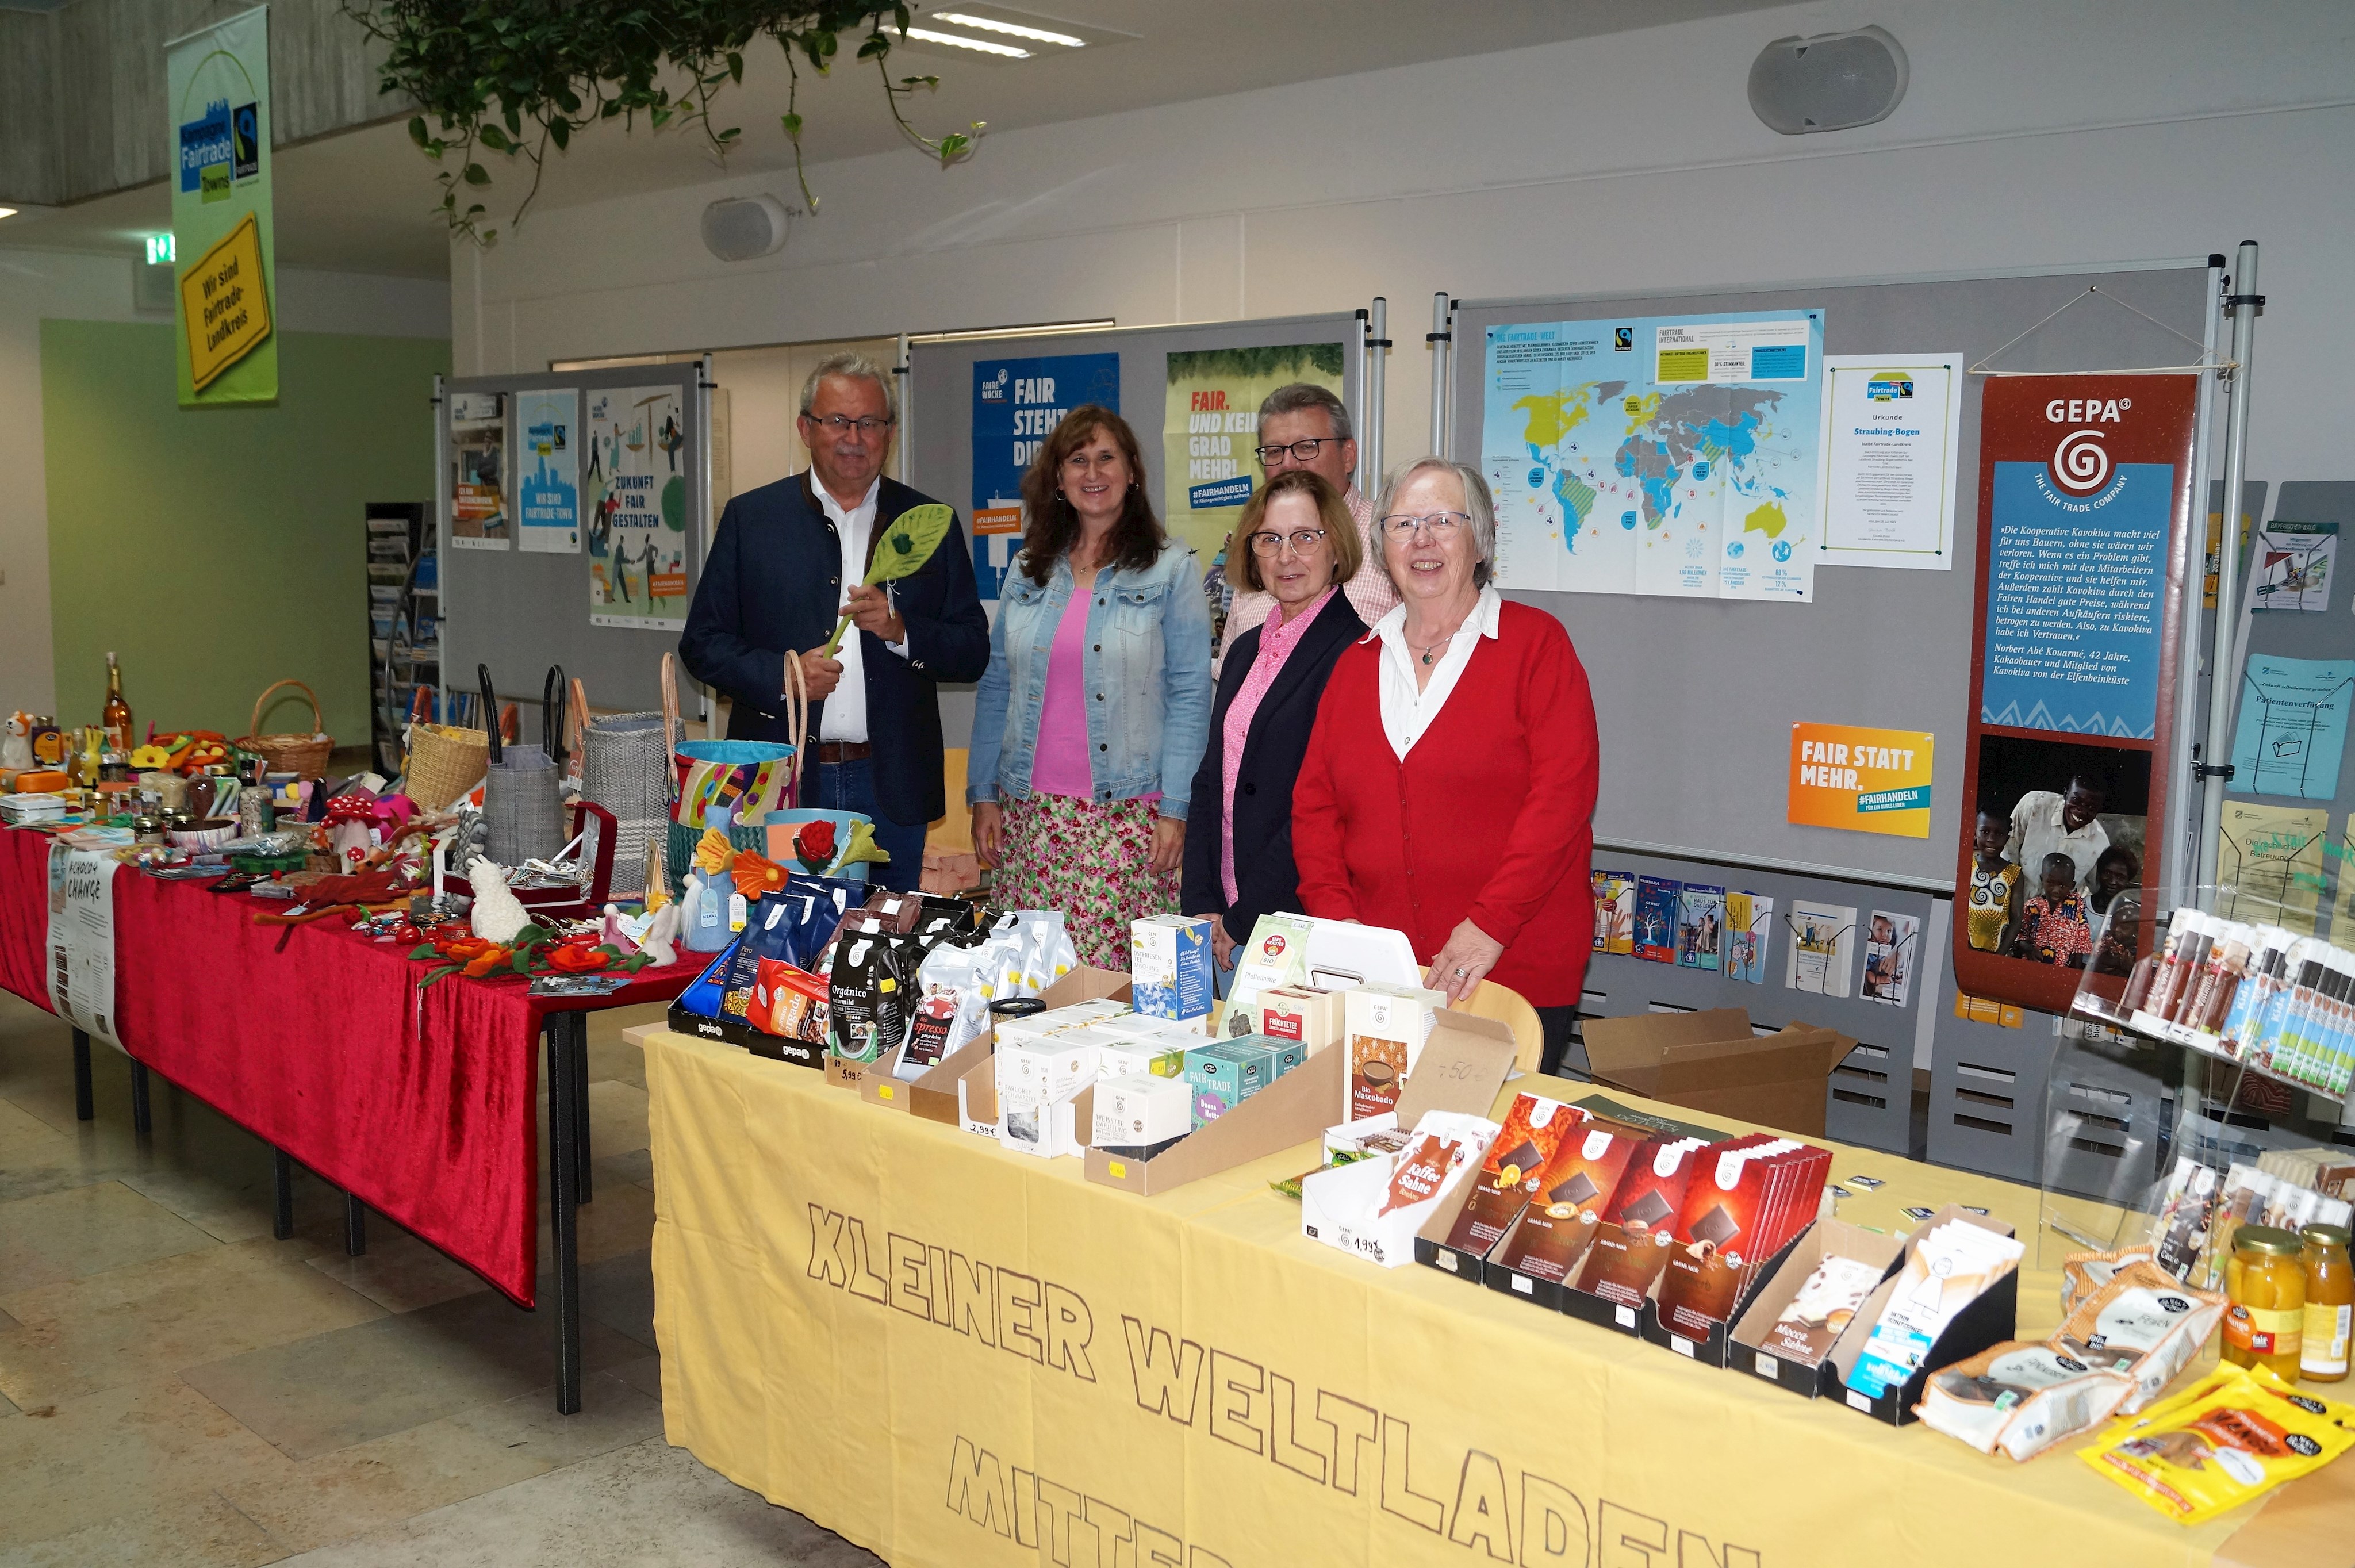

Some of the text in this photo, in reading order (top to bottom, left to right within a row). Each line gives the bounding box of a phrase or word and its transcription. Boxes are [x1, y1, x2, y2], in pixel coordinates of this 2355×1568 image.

[182, 139, 231, 170] Fairtrade
[203, 255, 239, 299] Wir sind
[207, 310, 248, 352] Landkreis
[1659, 335, 1694, 343] INTERNATIONAL
[982, 381, 999, 390] FAIRE
[1014, 378, 1055, 404] FAIR
[982, 390, 1002, 399] WOCHE
[1191, 390, 1230, 412] FAIR.
[1188, 413, 1221, 434] UND
[1854, 427, 1920, 437] Straubing-Bogen
[1188, 436, 1232, 457] GRAD
[1189, 458, 1238, 480] MEHR!
[616, 475, 654, 489] ZUKUNFT
[1192, 483, 1249, 499] #FAIRHANDELN
[2034, 472, 2128, 513] THE FAIR TRADE COMPANY
[536, 493, 561, 505] WIR SIND
[625, 494, 645, 509] FAIR
[526, 507, 572, 520] FAIRTRADE-TOWN
[613, 513, 659, 528] GESTALTEN
[976, 514, 1017, 524] #FAIRHANDELN
[2001, 526, 2160, 539] »Die Kooperative Kavokiva macht viel
[1998, 536, 2013, 547] für
[2032, 538, 2065, 548] Bauern,
[2069, 539, 2089, 548] ohne
[2092, 540, 2104, 549] sie
[2108, 542, 2134, 550] wären
[2138, 542, 2154, 550] wir
[2000, 549, 2034, 557] verloren.
[2039, 550, 2062, 558] Wenn
[2077, 551, 2089, 560] ein
[2093, 552, 2128, 561] Problem
[2131, 554, 2151, 563] gibt,
[1999, 559, 2153, 574] treffe ich mich mit den Mitarbeitern
[1998, 570, 2147, 586] der Kooperative und sie helfen mir.
[1997, 582, 2154, 598] Außerdem zahlt Kavokiva durch den
[1997, 593, 2150, 609] Fairen Handel gute Preise, während
[1997, 605, 2150, 623] ich bei anderen Aufkäufern riskiere,
[1996, 616, 2028, 627] betrogen
[2042, 620, 2073, 628] werden.
[2076, 621, 2096, 631] Also,
[2112, 623, 2152, 634] Kavokiva
[1995, 627, 2080, 641] habe ich Vertrauen.«
[1995, 643, 2024, 653] Norbert
[2027, 646, 2043, 655] Abé
[2046, 647, 2085, 659] Kouarmé,
[2103, 652, 2130, 662] Jahre,
[1994, 655, 2042, 666] Kakaobauer
[2045, 660, 2061, 668] und
[2063, 660, 2099, 672] Mitglied
[1993, 666, 2030, 676] Kavokiva
[2050, 670, 2065, 679] der
[2066, 672, 2130, 685] Elfenbeinküste
[2256, 695, 2334, 710] Patientenverfügung
[1801, 740, 1915, 771] FAIR STATT
[1800, 764, 1863, 791] MEHR.
[1858, 790, 1919, 805] #FAIRHANDELN
[2262, 841, 2297, 851] rechtliche
[2250, 850, 2289, 862] Betreuung
[1639, 878, 1660, 886] FRAUENHAUS
[68, 879, 101, 904] CHANGE
[741, 945, 753, 953] Peru
[1267, 940, 1284, 948] KRÄUTER
[1133, 950, 1161, 961] OSTFRIESEN
[1134, 963, 1159, 972] MISCHUNG
[1245, 972, 1276, 983] Pfefferminze
[831, 984, 867, 998] Orgánico
[2237, 984, 2250, 1011] Kids
[833, 998, 854, 1006] naturmild
[2270, 994, 2285, 1022] Kids
[783, 994, 801, 1038] Cargado
[1269, 1017, 1298, 1030] FRÜCHTETEE
[698, 1023, 715, 1033] gepa
[783, 1045, 802, 1057] gepa
[842, 1069, 856, 1080] 5,99
[1190, 1071, 1207, 1084] FAIR
[1207, 1079, 1232, 1092] TRADE
[1354, 1090, 1393, 1105] Mascobado
[1096, 1114, 1125, 1127] WEISSTEE
[1096, 1121, 1127, 1135] DARJEELING
[1406, 1162, 1441, 1183] Kaffee
[1398, 1174, 1432, 1195] Sahne
[807, 1202, 1096, 1383] KLEINER
[2227, 1314, 2250, 1332] Mango
[1774, 1323, 1808, 1341] Mocca
[2252, 1334, 2268, 1345] fair
[1781, 1337, 1813, 1355] Sahne
[946, 1435, 1228, 1568] MITTE
